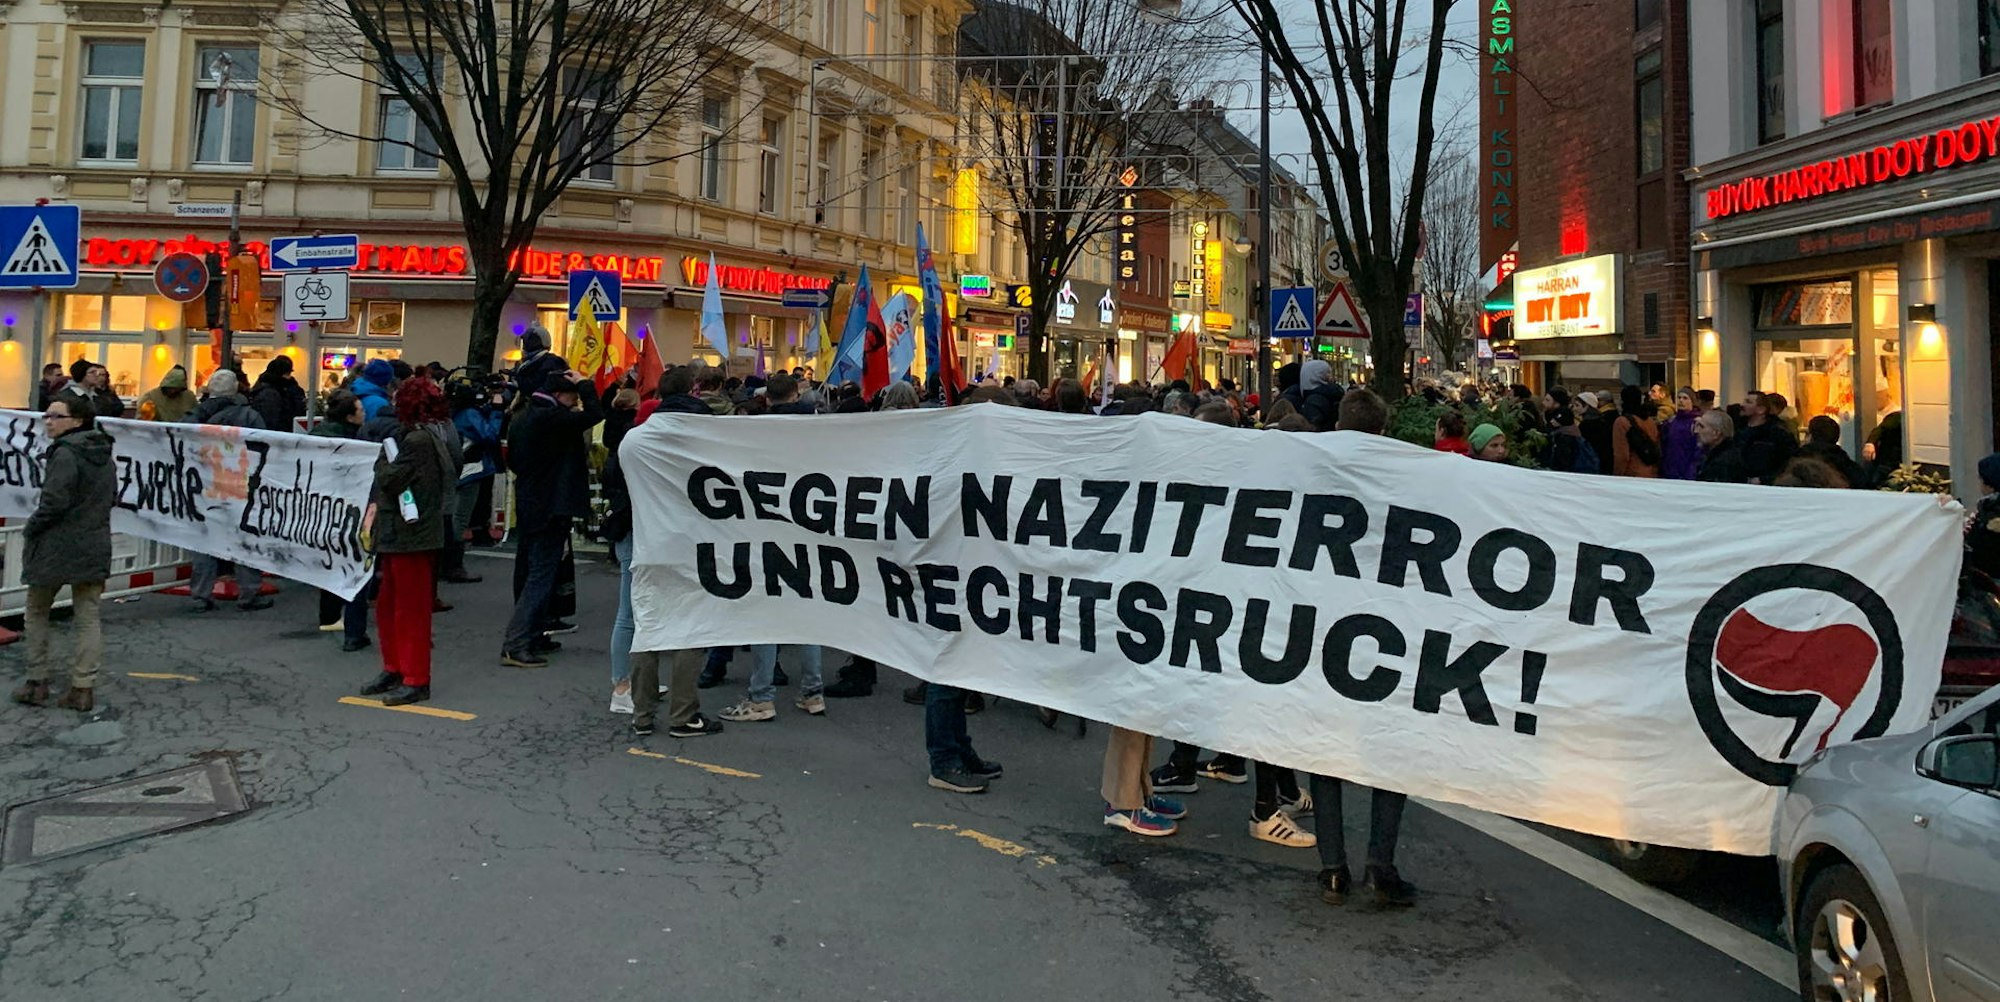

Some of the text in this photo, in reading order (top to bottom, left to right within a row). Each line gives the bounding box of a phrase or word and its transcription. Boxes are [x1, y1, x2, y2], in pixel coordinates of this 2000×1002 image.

[1491, 129, 1513, 228] KONAK
[1707, 117, 2000, 219] BÜYÜK HARRAN DOY DOY
[87, 237, 159, 266] DOY
[566, 252, 586, 272] &
[592, 254, 664, 282] SALAT
[1119, 193, 1138, 278] Teras
[1537, 275, 1579, 294] HARRAN
[687, 464, 1654, 634] GEGEN NAZITERROR
[695, 540, 1549, 735] UND RECHTSRUCK!
